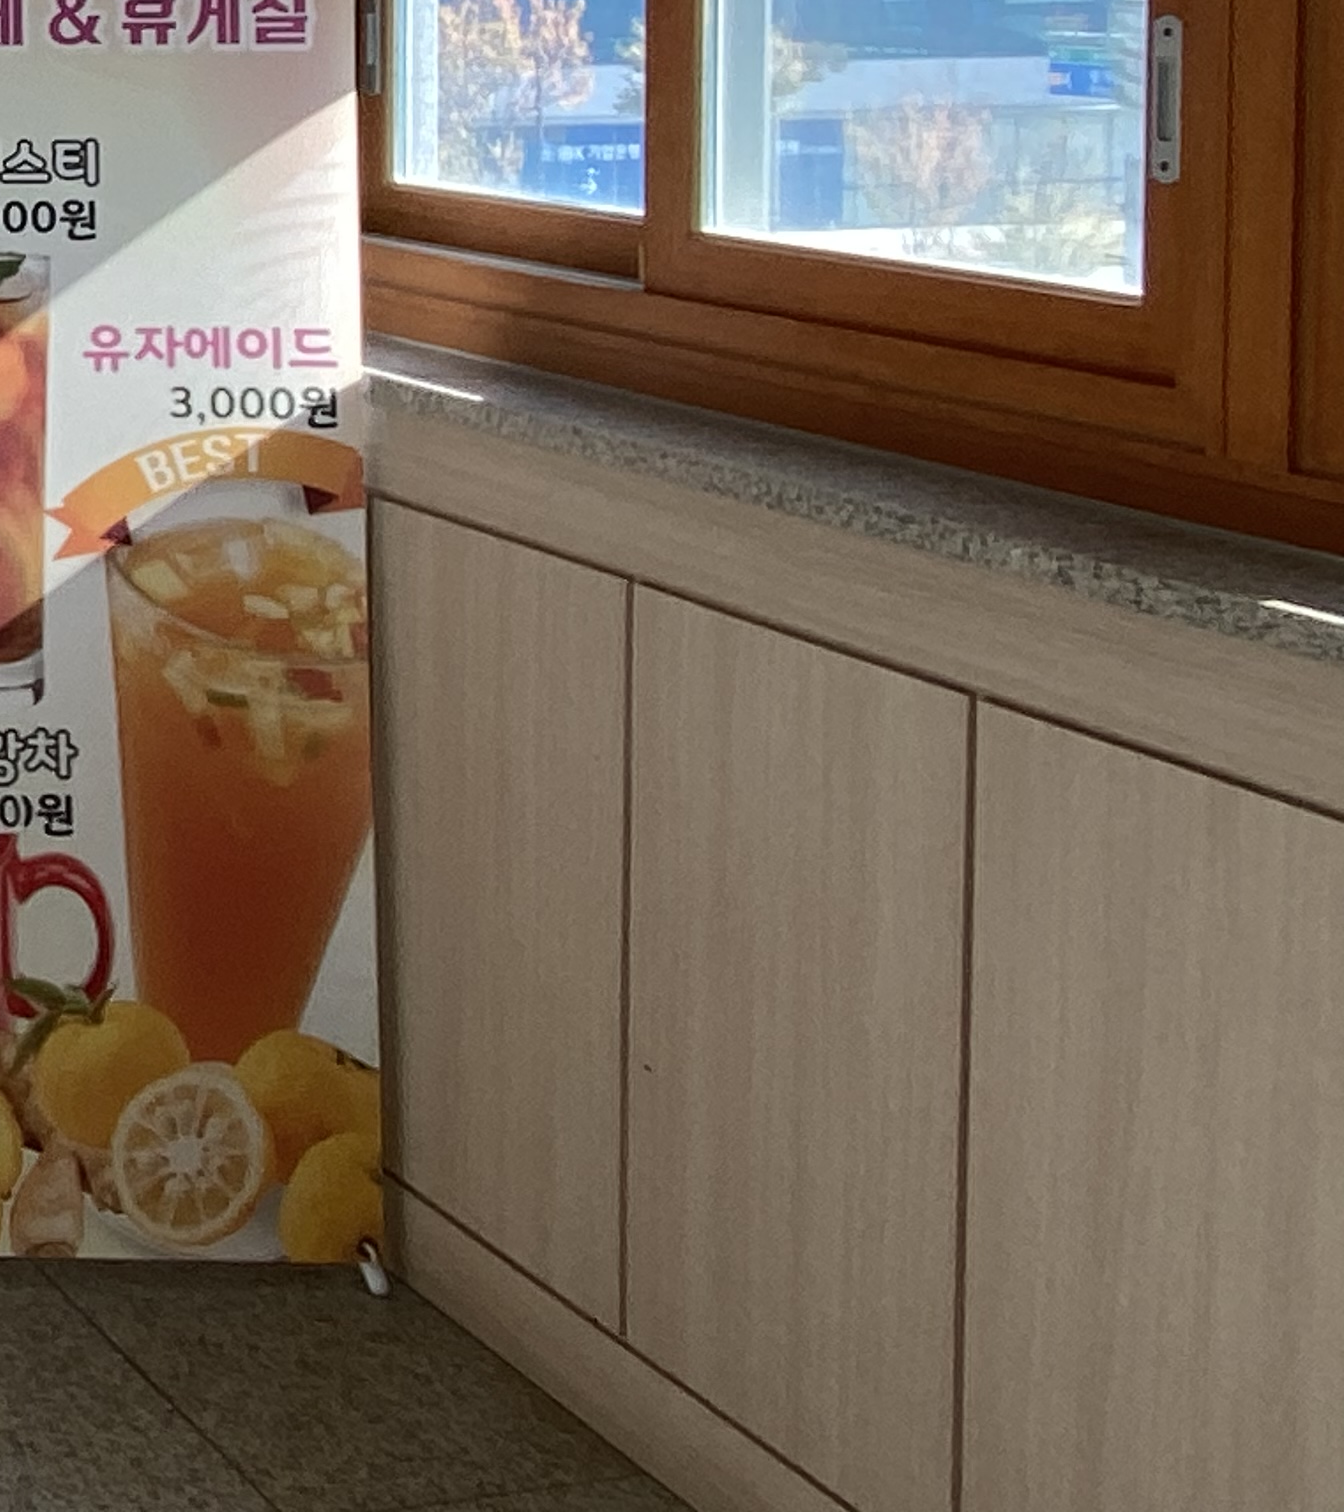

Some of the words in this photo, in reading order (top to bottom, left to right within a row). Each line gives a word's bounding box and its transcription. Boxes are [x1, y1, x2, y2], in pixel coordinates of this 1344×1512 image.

[82, 323, 340, 372] 유자에이드
[169, 385, 340, 429] 3,000원
[133, 433, 266, 494] BEST
